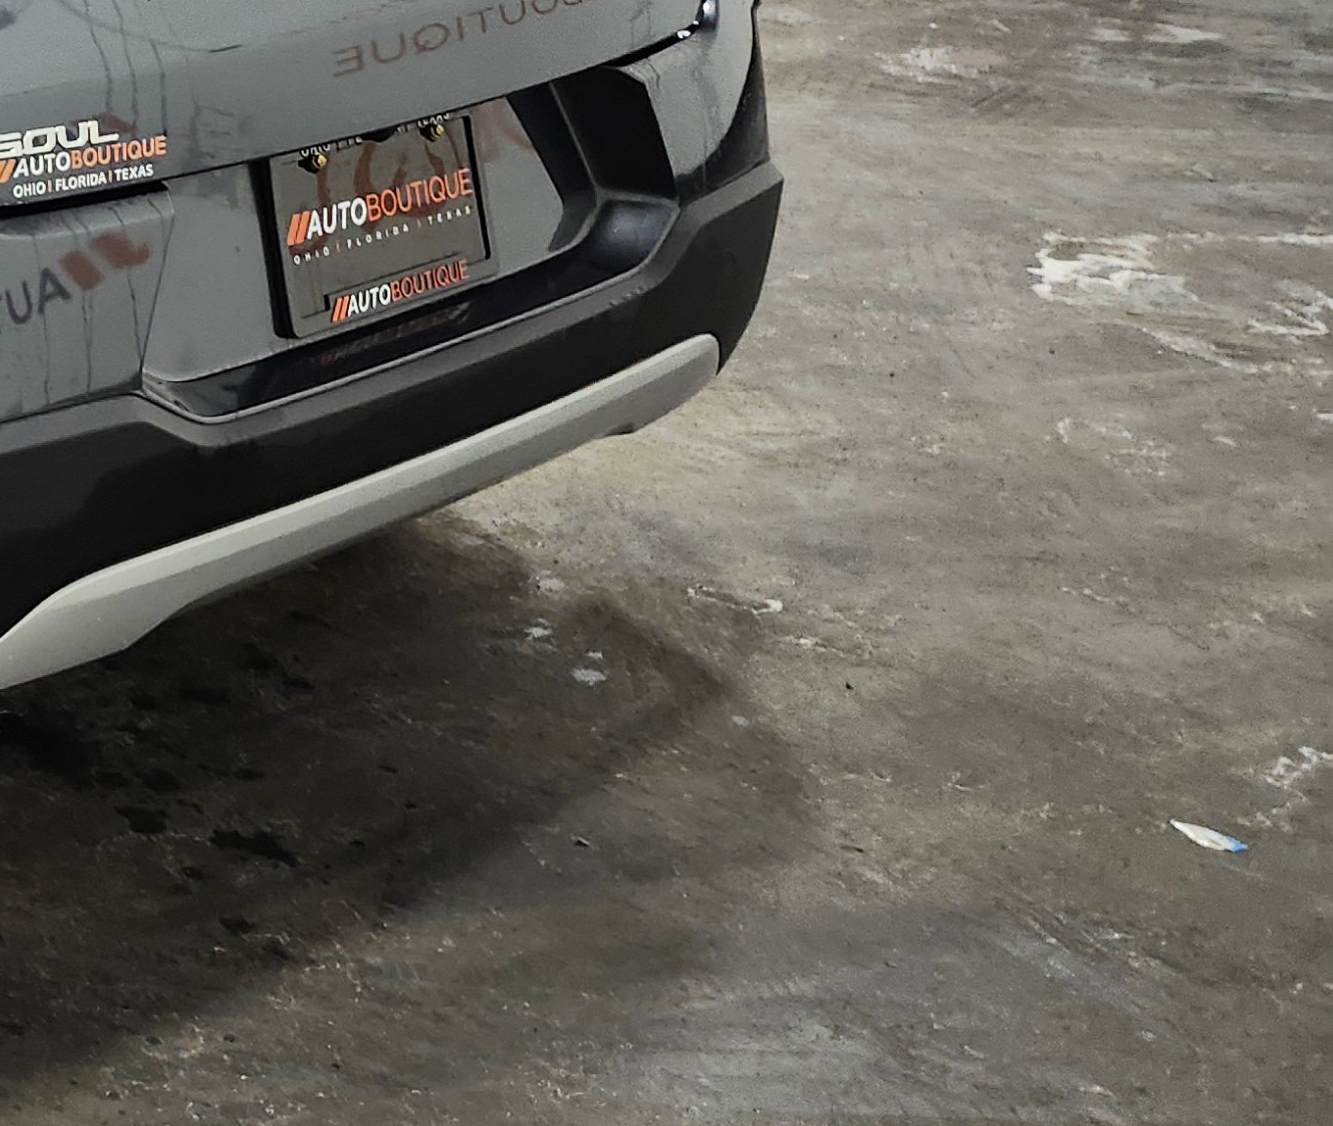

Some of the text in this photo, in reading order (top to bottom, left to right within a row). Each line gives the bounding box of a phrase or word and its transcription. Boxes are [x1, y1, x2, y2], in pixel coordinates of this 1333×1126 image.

[13, 135, 167, 178] AUTOBOUTIQUE
[13, 163, 153, 199] OHIO FLORIDA TEXAS
[307, 168, 473, 240] AUTOBOUTIQUE
[293, 205, 471, 266] OHIO FLORIDA TEXAS
[347, 259, 469, 317] AUTOBOUTIQUE
